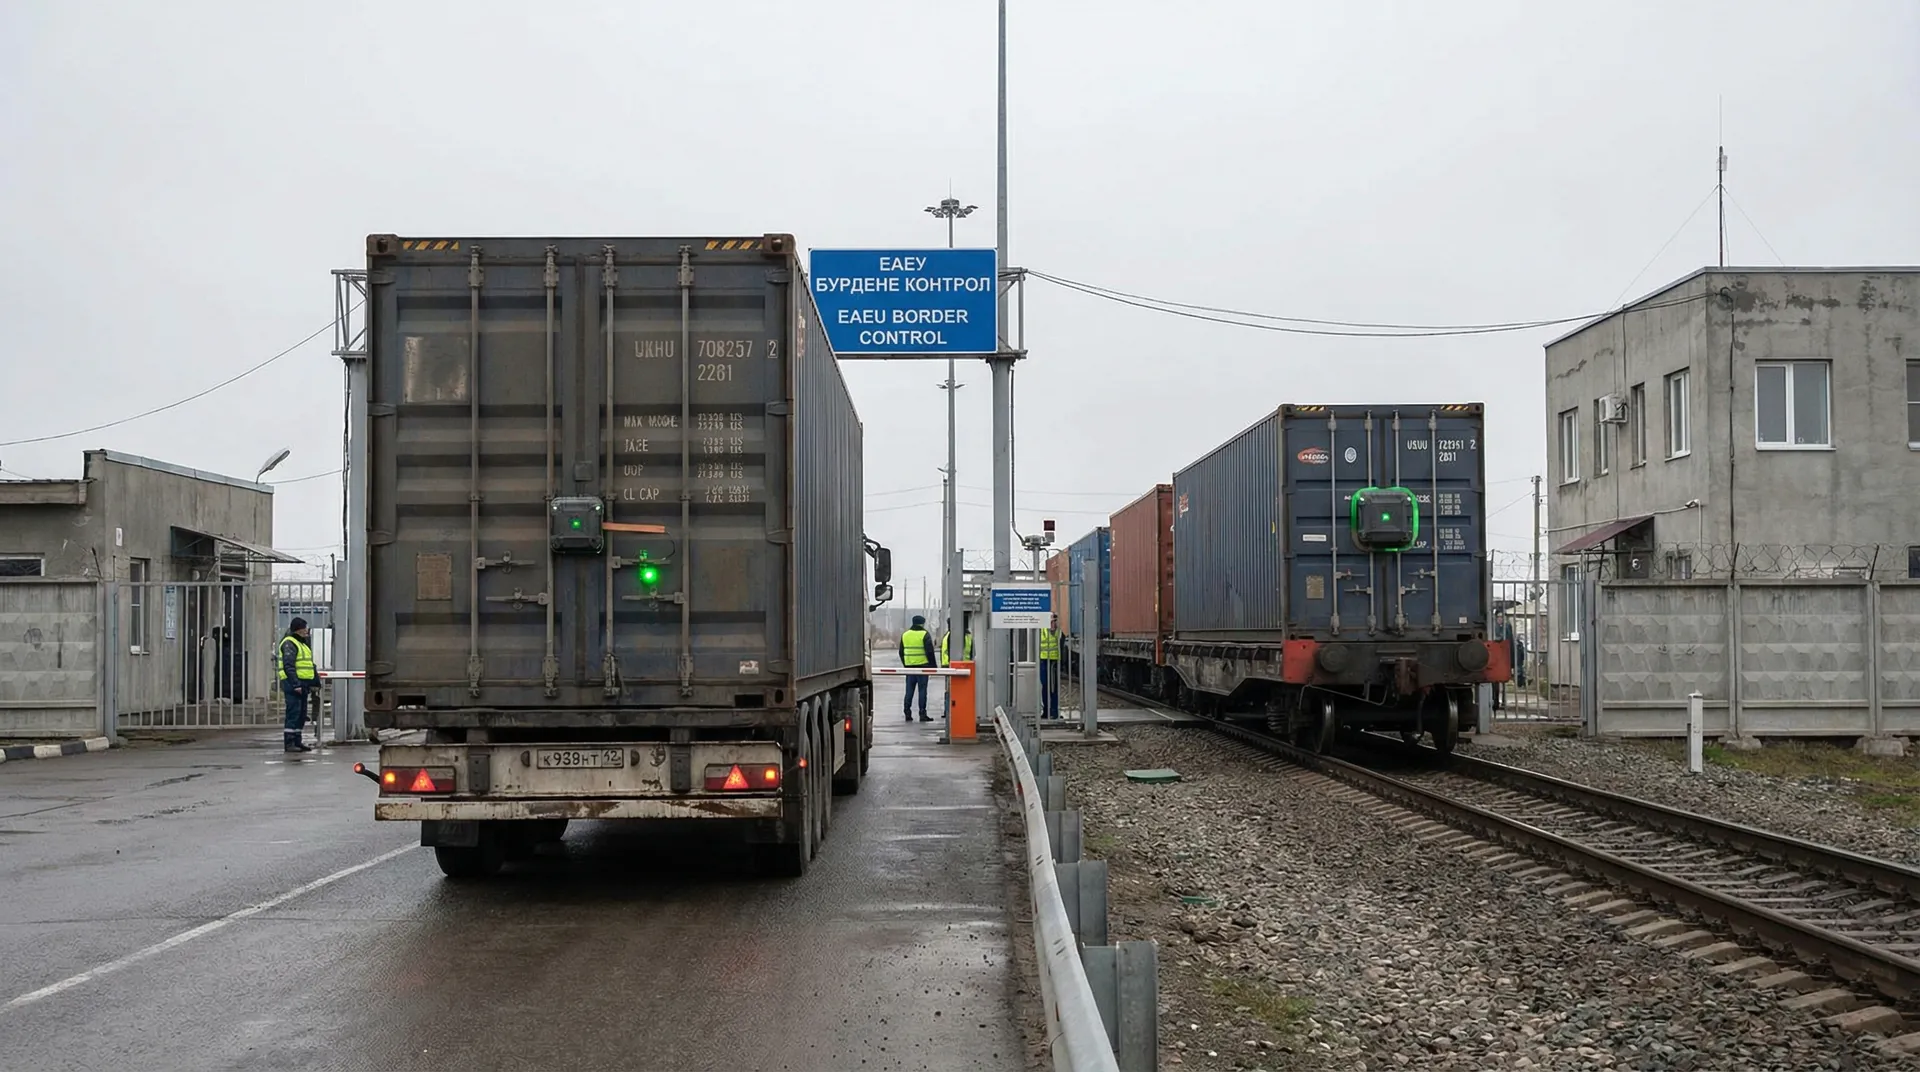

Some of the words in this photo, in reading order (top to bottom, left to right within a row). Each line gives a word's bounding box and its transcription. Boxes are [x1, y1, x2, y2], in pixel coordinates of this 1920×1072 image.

[879, 256, 927, 271] ЕАЕУ
[816, 277, 900, 294] БУРДЕНЕ
[905, 277, 991, 292] КОНТРОЛ
[838, 309, 886, 324] EAEU
[892, 309, 969, 324] BORDER
[859, 330, 948, 345] CONTROL
[697, 340, 754, 358] 708257
[768, 340, 778, 358] 2
[639, 487, 660, 501] CAP
